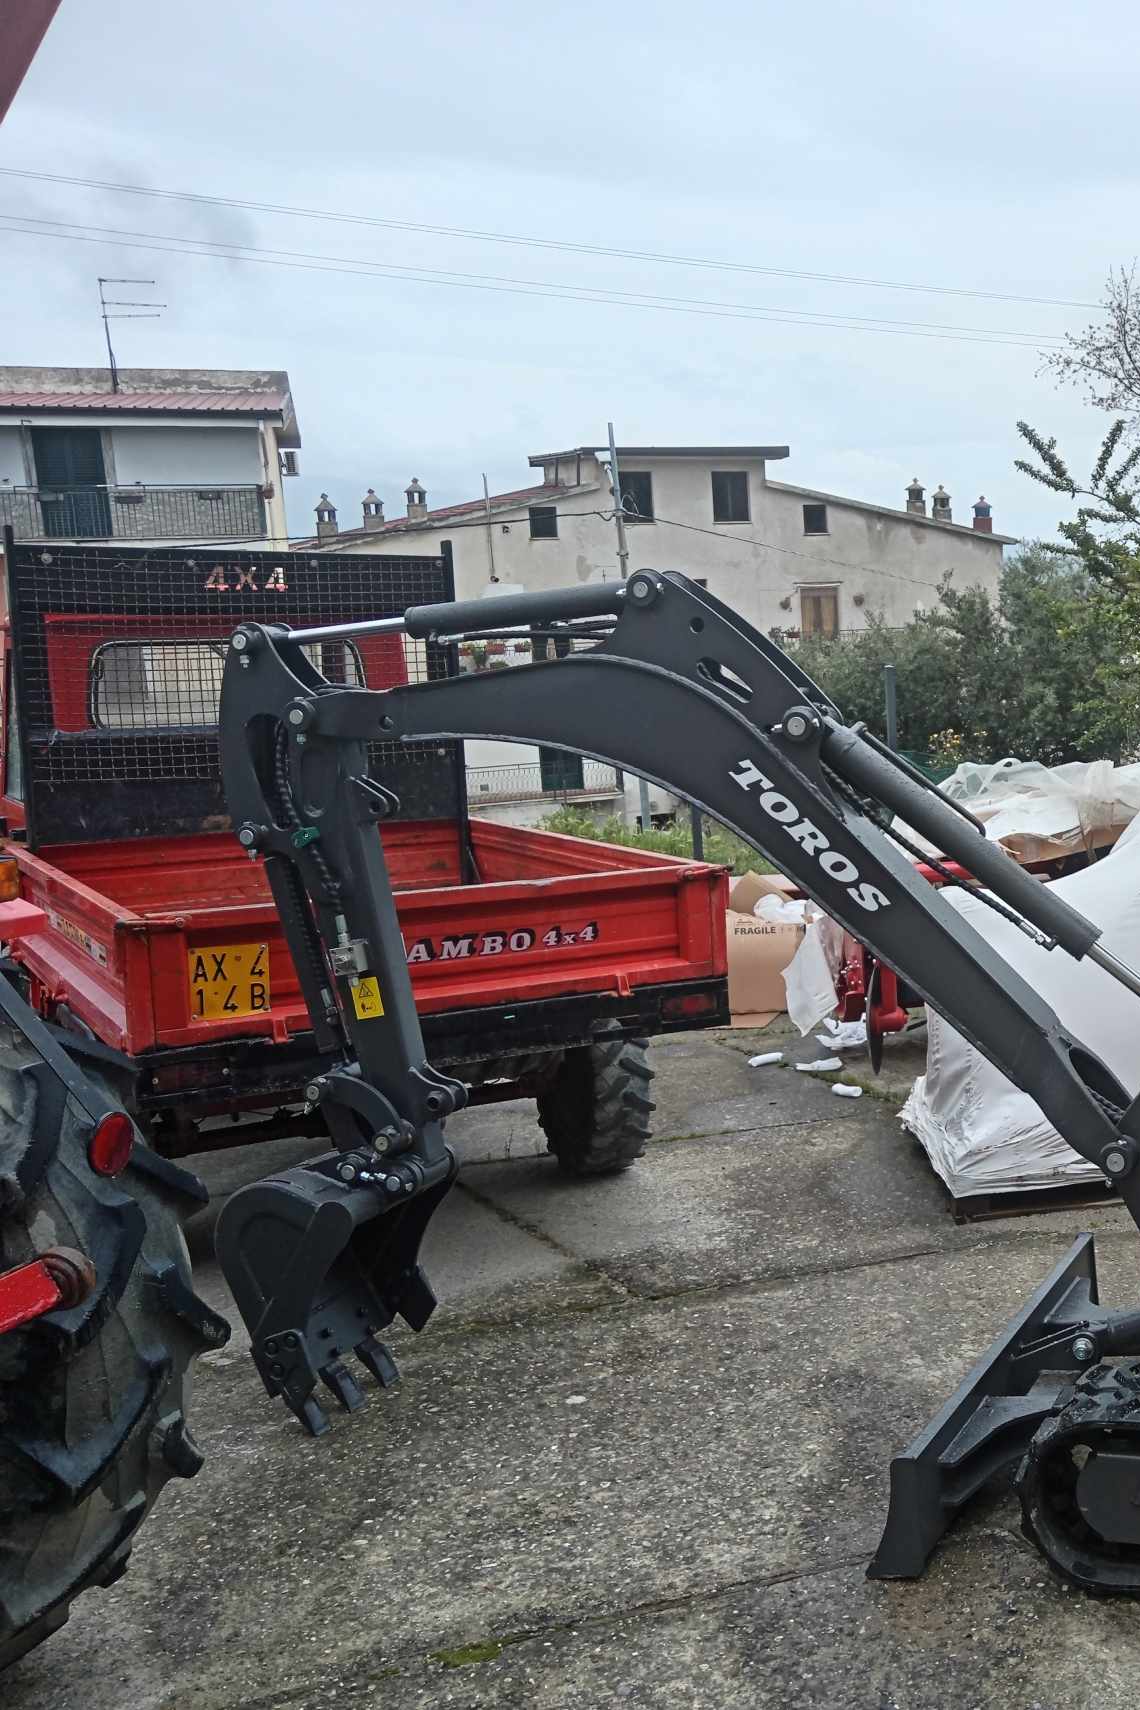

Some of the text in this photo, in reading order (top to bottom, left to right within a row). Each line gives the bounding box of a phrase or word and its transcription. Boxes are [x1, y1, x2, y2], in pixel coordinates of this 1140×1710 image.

[728, 759, 891, 912] TOROS
[400, 921, 598, 963] AMBO 4x4
[734, 926, 776, 936] FRAGILE
[193, 953, 228, 983] AX
